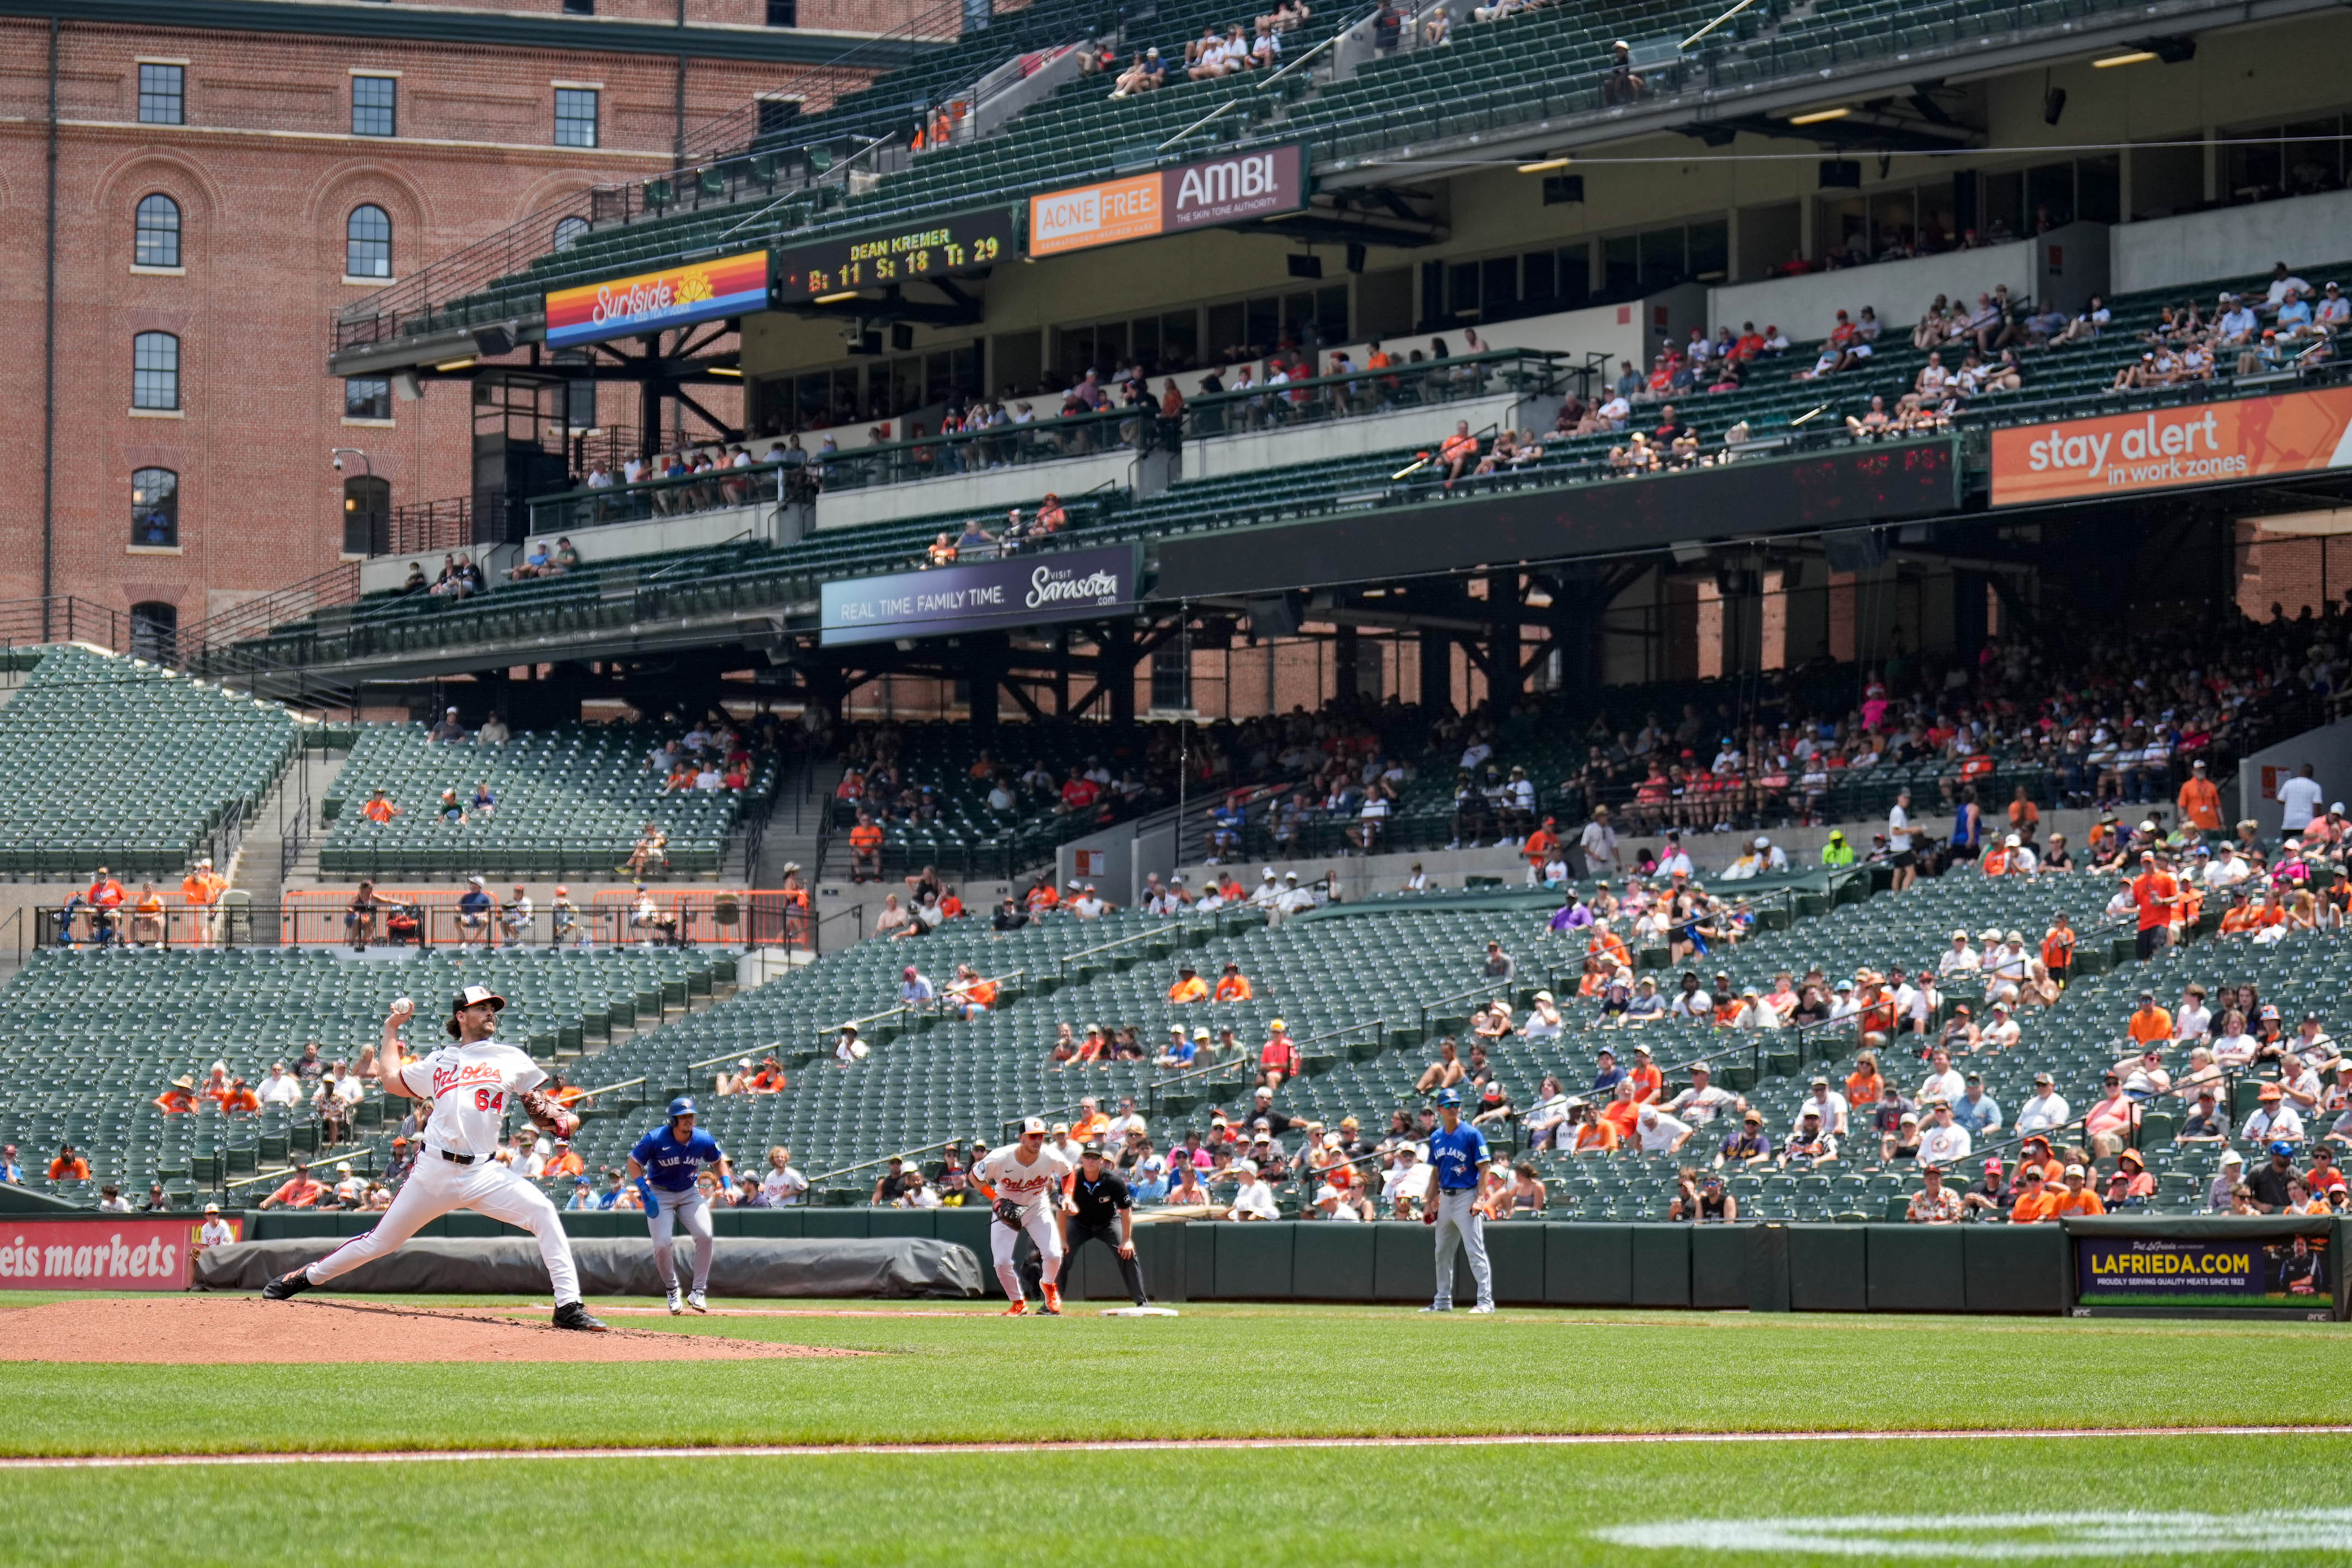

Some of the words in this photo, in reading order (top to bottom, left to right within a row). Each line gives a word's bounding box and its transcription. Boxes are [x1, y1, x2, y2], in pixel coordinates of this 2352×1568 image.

[1042, 200, 1093, 230] ACNE
[1177, 213, 1191, 223] THE
[1193, 210, 1210, 221] SKIN
[1211, 206, 1231, 218] TONE
[1233, 196, 1276, 213] AUTHORITY
[850, 240, 888, 261] DEAN
[892, 228, 952, 253] KREMER
[839, 262, 861, 286] 11
[905, 250, 930, 274] 18
[974, 237, 999, 262] 29
[593, 278, 671, 326] Surfside
[2029, 429, 2112, 477] stay
[2120, 411, 2219, 460] alert
[2108, 463, 2126, 485] in
[2129, 456, 2182, 482] work
[2185, 454, 2246, 477] zones
[1025, 566, 1117, 609] Sarasota
[1049, 569, 1071, 580] VISIT
[841, 602, 874, 620] REAL
[879, 598, 914, 617] TIME.
[917, 590, 966, 612] FAMILY
[968, 585, 1005, 606] TIME.
[1096, 595, 1116, 606] .com
[475, 1088, 503, 1114] 64
[1447, 1147, 1467, 1162] JAYS
[44, 1233, 176, 1277] markets
[2091, 1254, 2249, 1274] LAFRIEDA.COM
[2097, 1277, 2127, 1286] PROUDLY
[2128, 1277, 2156, 1286] SERVING
[2157, 1277, 2185, 1286] QUALITY
[2186, 1277, 2208, 1286] MEATS
[2209, 1277, 2229, 1286] SINCE
[2230, 1277, 2245, 1286] 1922
